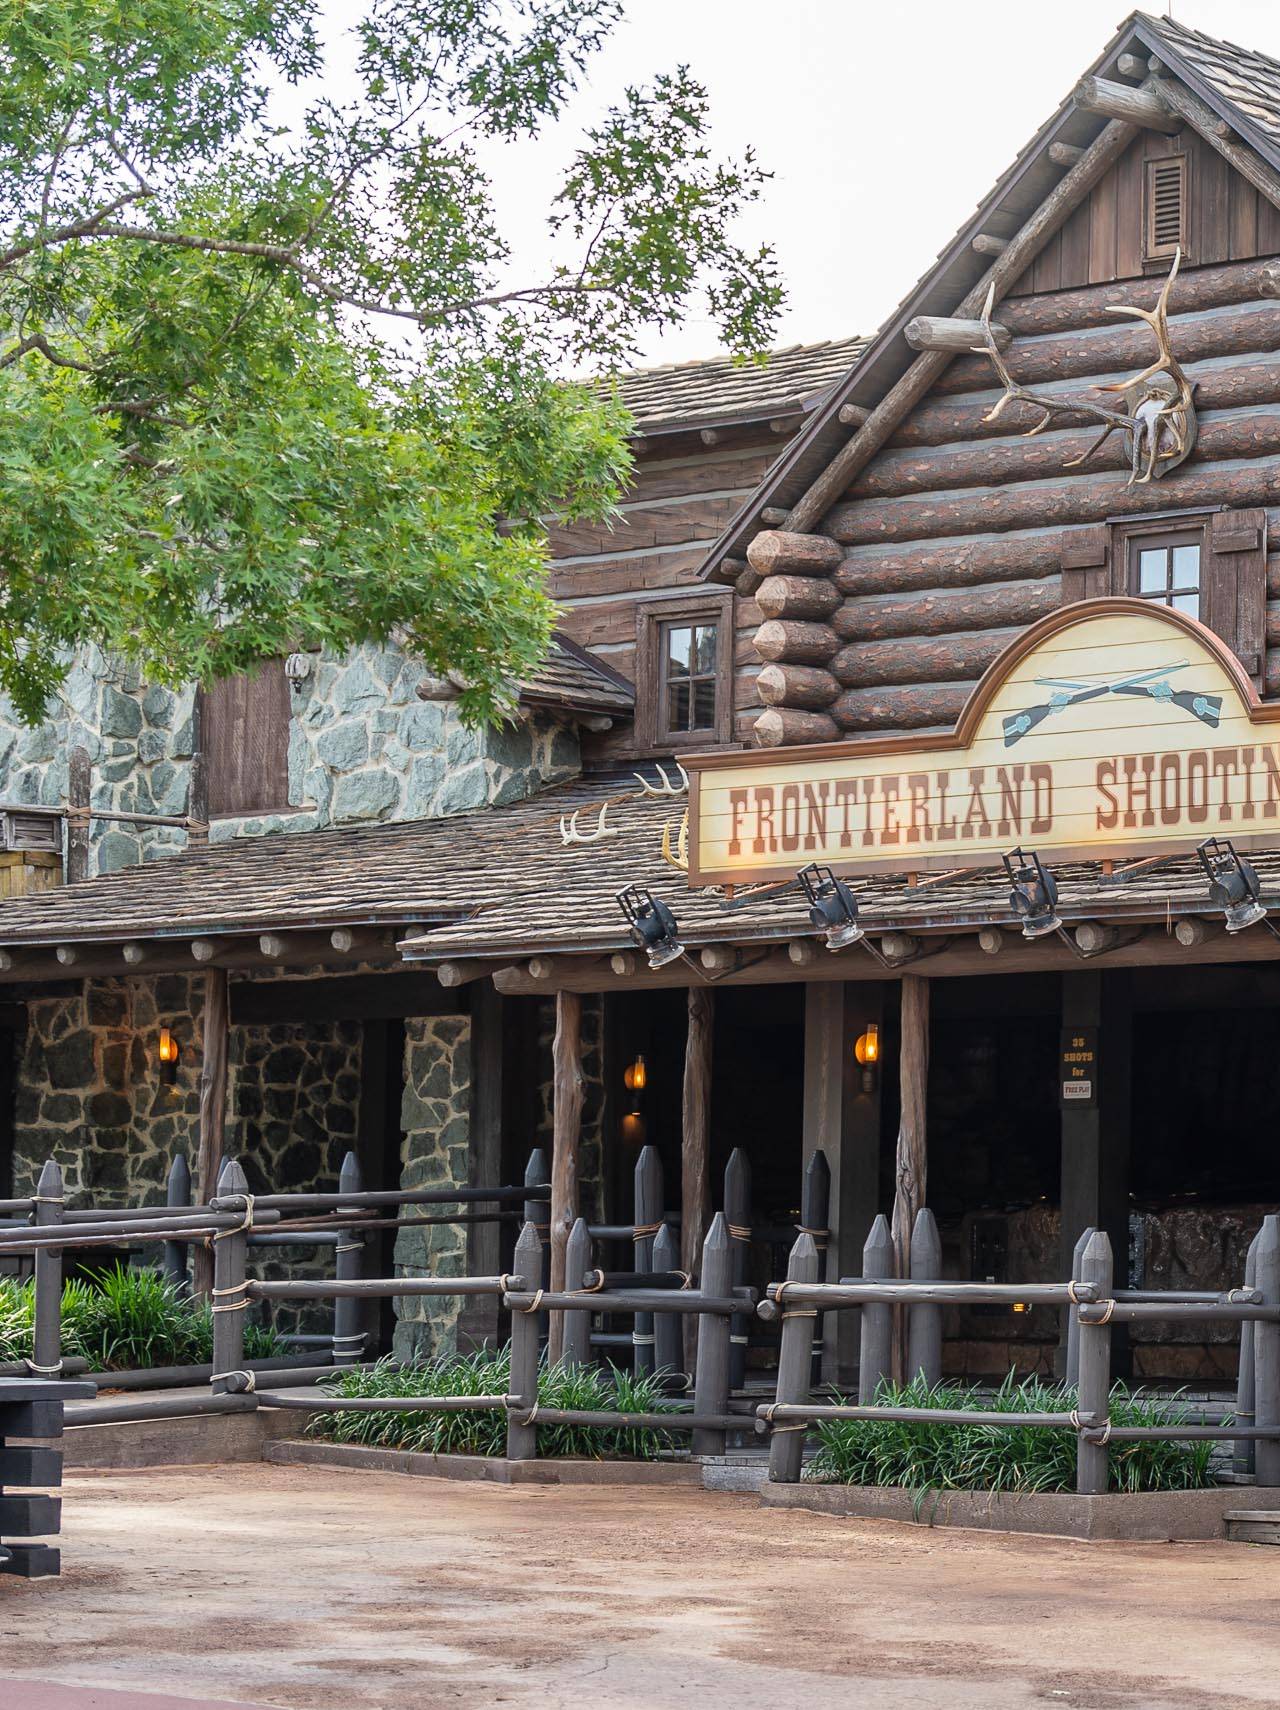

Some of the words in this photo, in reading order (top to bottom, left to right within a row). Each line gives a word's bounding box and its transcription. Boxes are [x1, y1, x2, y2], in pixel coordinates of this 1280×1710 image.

[728, 763, 1055, 856] FRONTIERLAND
[1063, 1052, 1093, 1062] SHOTS
[1071, 1067, 1085, 1077] for
